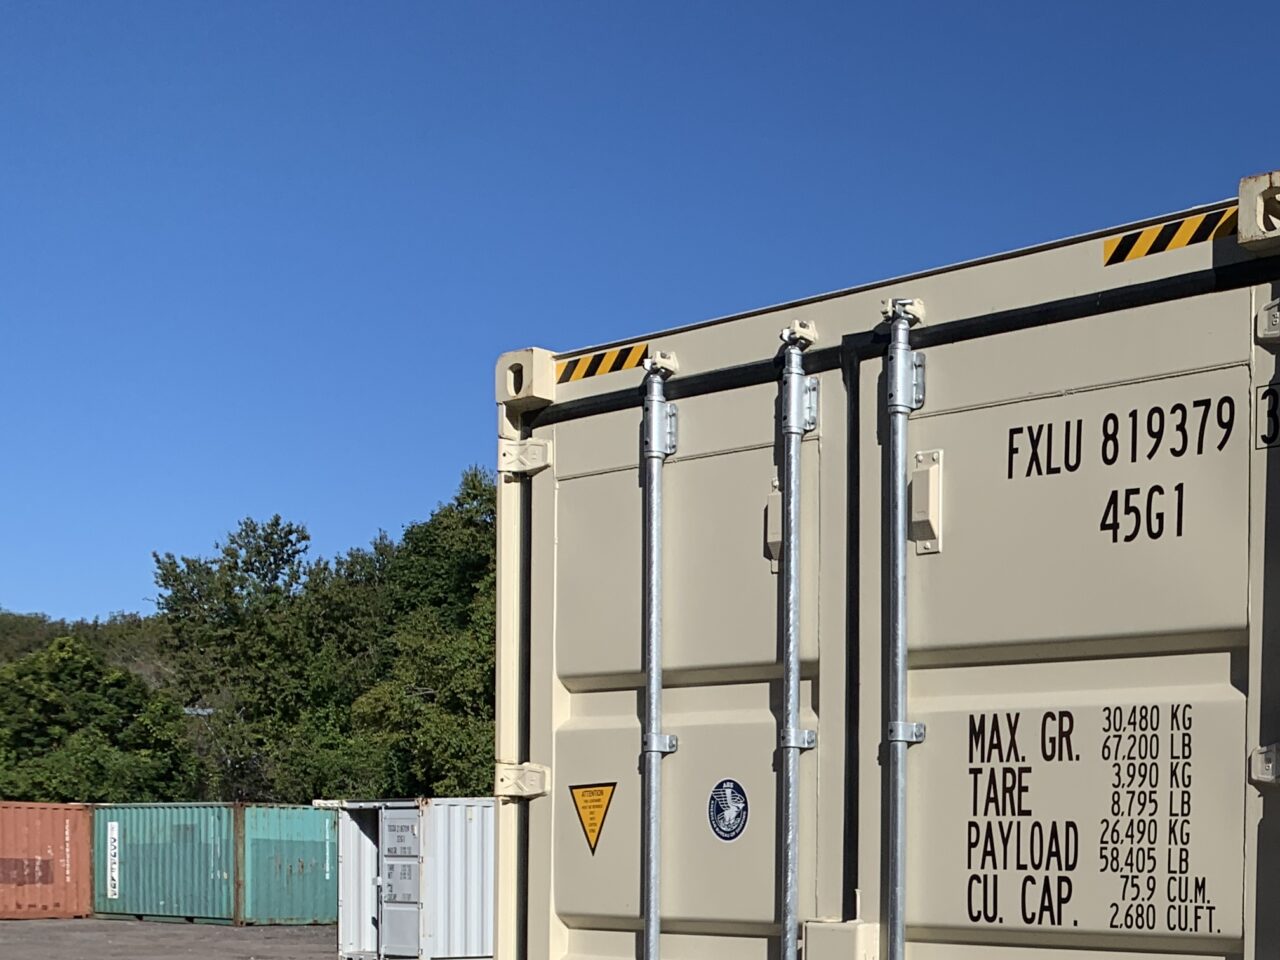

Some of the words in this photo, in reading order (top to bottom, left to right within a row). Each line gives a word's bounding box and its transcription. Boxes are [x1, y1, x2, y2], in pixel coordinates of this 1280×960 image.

[1007, 419, 1083, 479] FXLU
[1101, 396, 1235, 466] 819379
[1260, 388, 1280, 445] 3
[1100, 482, 1184, 543] 45G1
[1102, 705, 1160, 732] 30,480
[1170, 704, 1192, 731] KG
[968, 712, 1026, 763] MAX.
[1041, 710, 1080, 762] GR.
[1101, 734, 1159, 761] 67,200
[1170, 733, 1192, 760] LB
[1112, 762, 1159, 789] 3,990
[1169, 761, 1192, 789] KG
[968, 766, 1032, 817] TARE
[1111, 790, 1158, 817] 8,795
[1169, 790, 1191, 817] LB
[967, 820, 1079, 871] PAYLOAD
[1099, 819, 1157, 845] 26,490
[1168, 819, 1190, 846] KG
[1099, 846, 1157, 873] 58,405
[1167, 847, 1189, 874] LB
[967, 874, 1003, 923] CU.
[1021, 875, 1078, 927] CAP.
[1119, 875, 1156, 902] 75.9
[1109, 903, 1156, 930] 2,680
